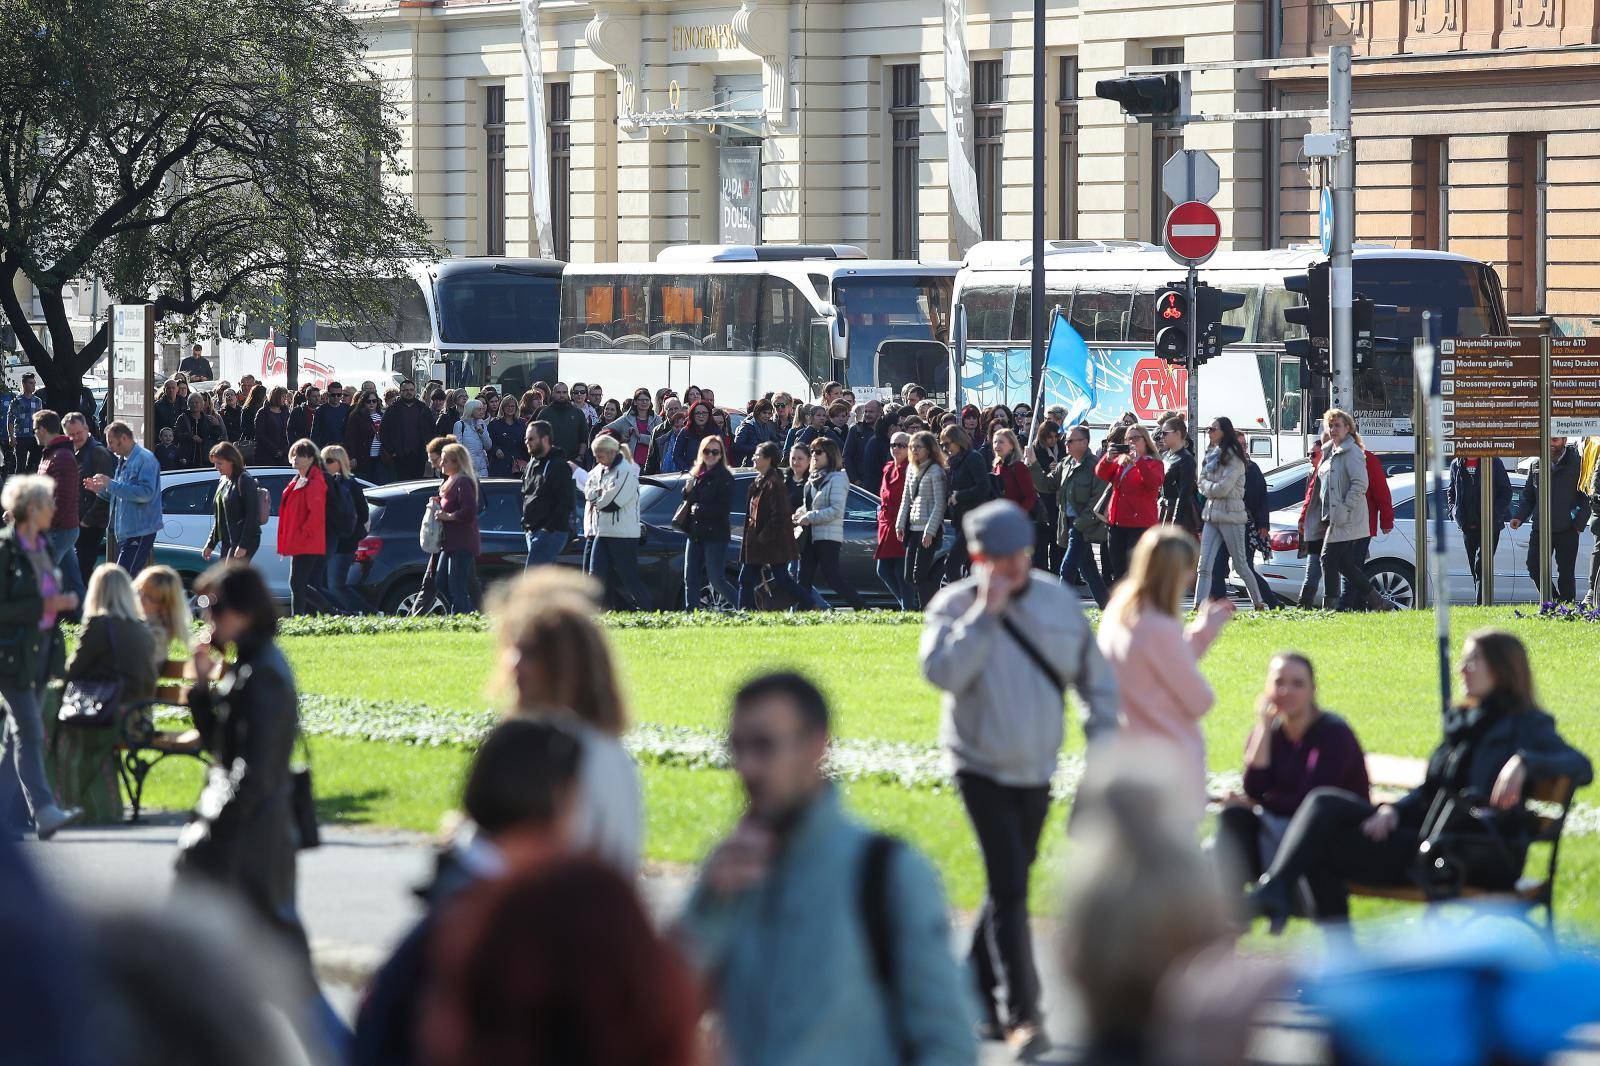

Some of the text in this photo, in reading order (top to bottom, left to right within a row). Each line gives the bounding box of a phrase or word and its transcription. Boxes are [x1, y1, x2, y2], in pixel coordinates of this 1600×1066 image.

[1456, 340, 1521, 348] Umjetnički paviljon
[1488, 360, 1513, 368] galerija
[1553, 359, 1599, 368] Muzej Dražen
[1456, 380, 1537, 388] Strossmayerova galerija
[1578, 380, 1597, 388] muzej
[1552, 400, 1573, 408] Muzej
[1353, 410, 1393, 418] OVREMENI
[1494, 441, 1515, 449] muzej
